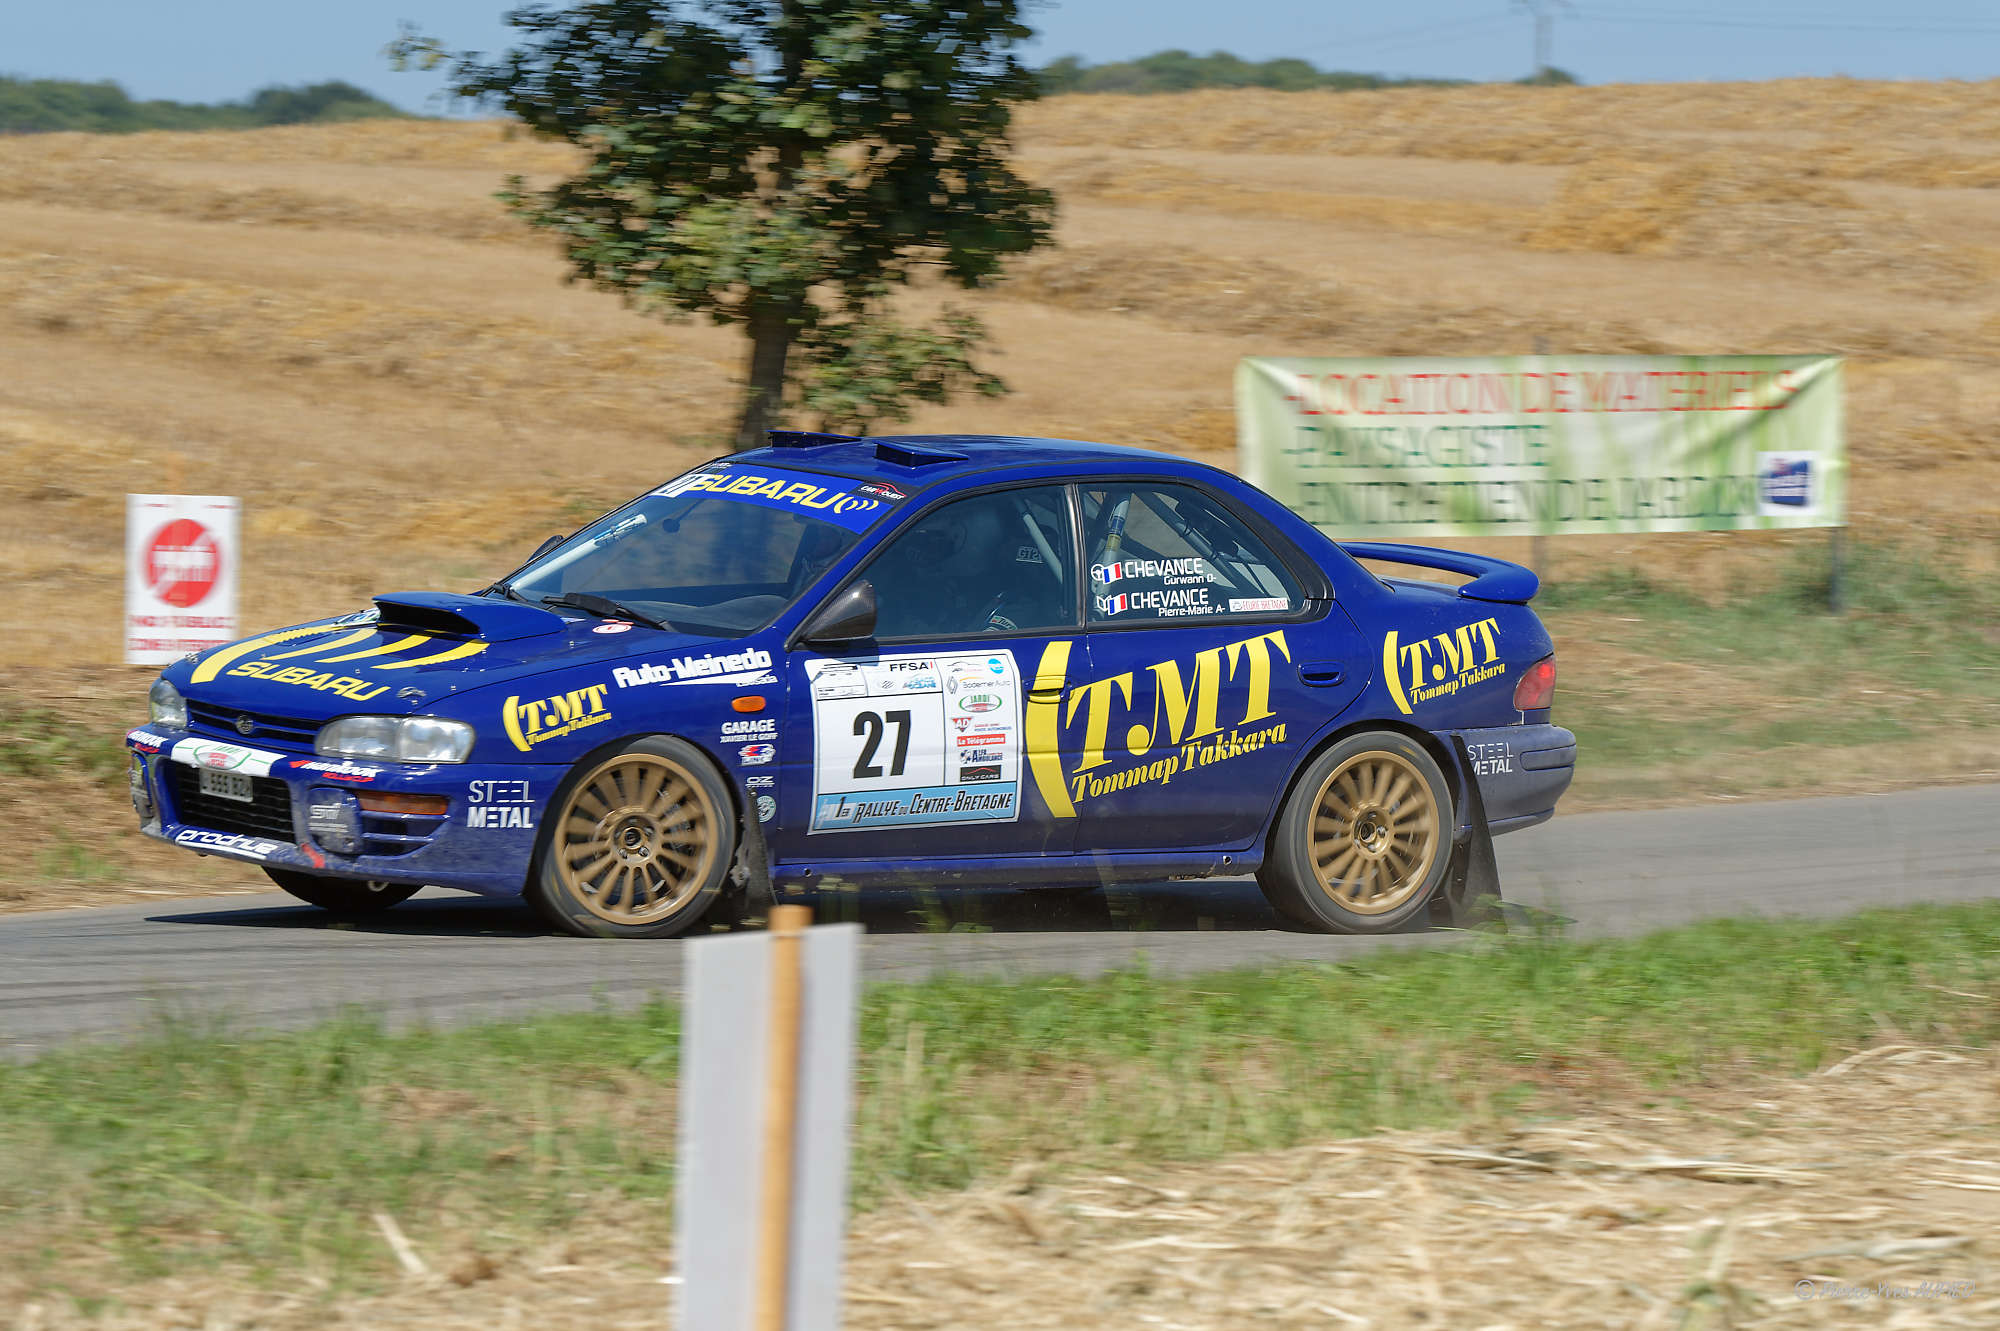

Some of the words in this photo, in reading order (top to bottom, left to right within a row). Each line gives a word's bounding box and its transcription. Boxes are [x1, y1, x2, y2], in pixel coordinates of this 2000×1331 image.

[686, 474, 847, 509] SUBARU
[1125, 557, 1204, 578] CHEVANCE
[1164, 575, 1204, 586] Gurwann
[1131, 588, 1209, 609] CHEVANCE
[1158, 604, 1213, 617] Pierre-Marie
[612, 647, 773, 688] Auto-Meinedo
[889, 662, 929, 672] FFSA
[226, 661, 391, 701] SUBARU
[1410, 678, 1458, 705] Tommap
[1458, 662, 1506, 688] Takkara
[721, 719, 776, 734] GARAGE
[853, 709, 911, 779] 27
[1467, 743, 1514, 761] STEEL
[1071, 755, 1179, 804] Tommap
[1181, 723, 1287, 772] Takkara
[746, 776, 774, 784] OZ
[467, 780, 535, 803] STEEL
[466, 806, 534, 828] METAL
[852, 800, 900, 824] RALLYE
